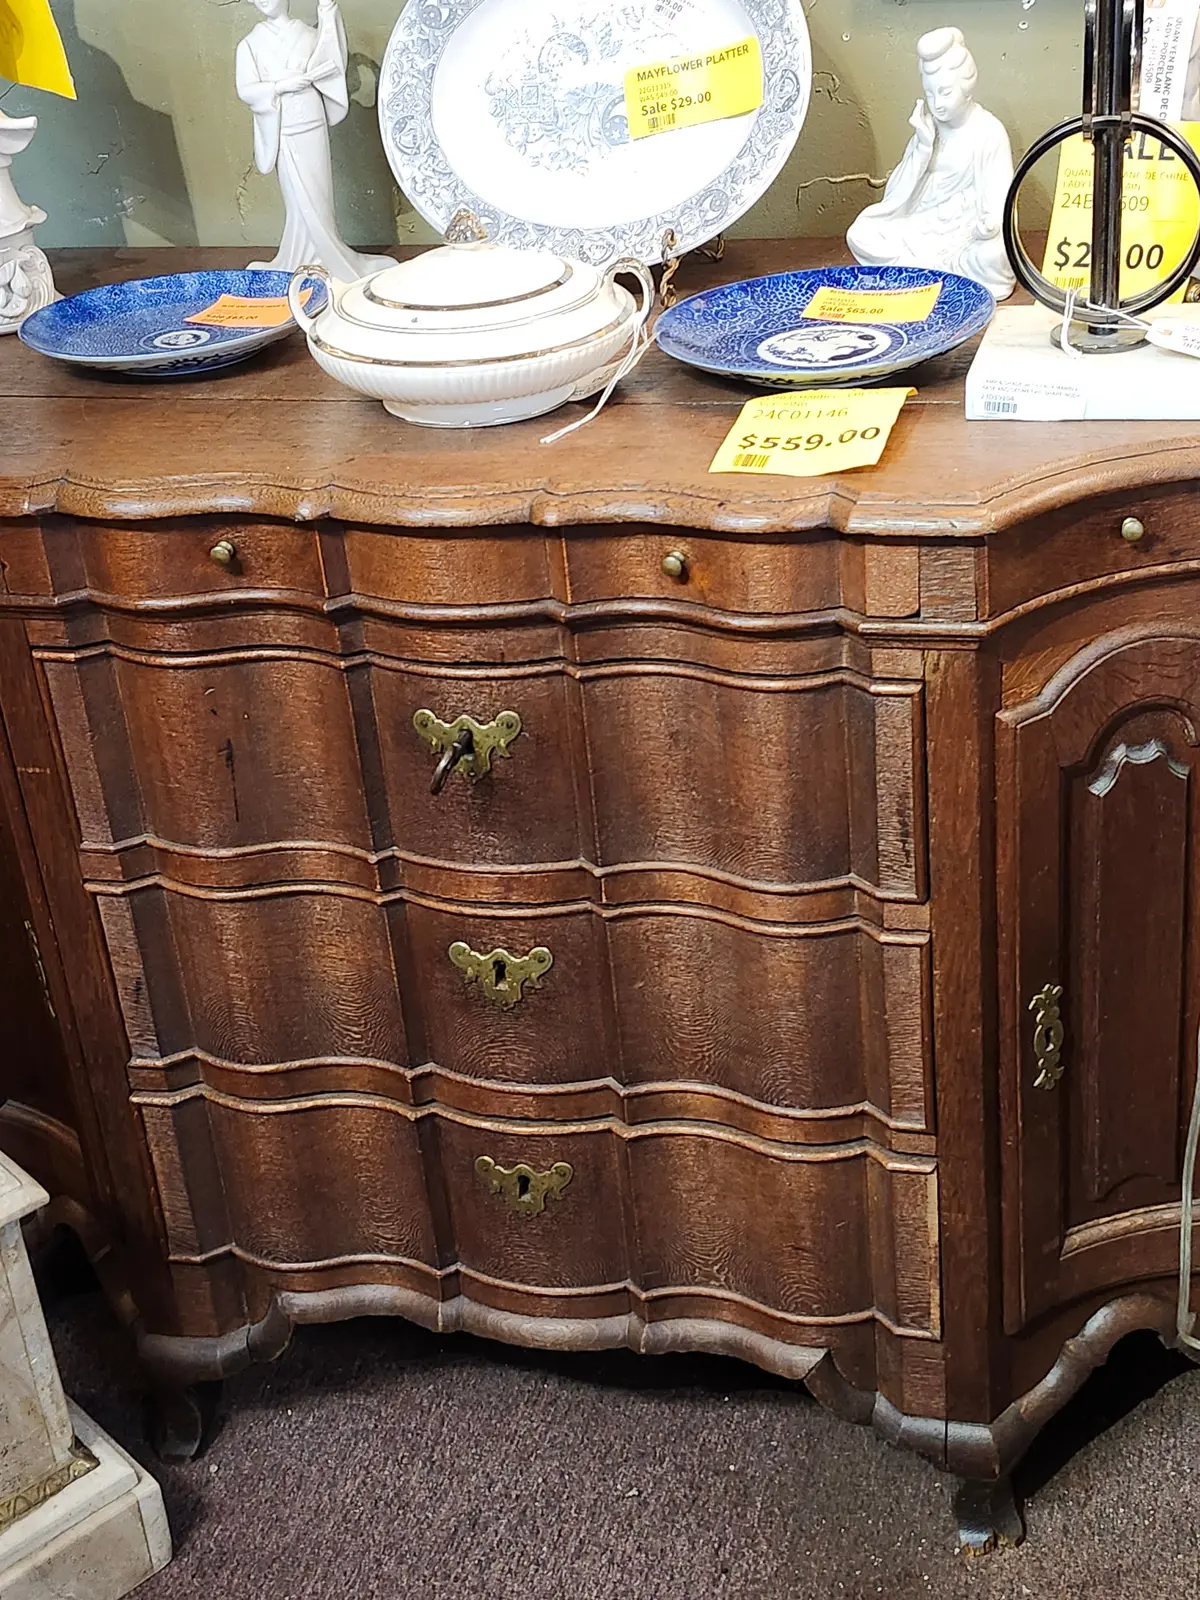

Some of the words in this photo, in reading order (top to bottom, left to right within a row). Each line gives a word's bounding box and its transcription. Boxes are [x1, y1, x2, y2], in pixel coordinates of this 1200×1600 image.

[1173, 17, 1183, 42] QUAN
[637, 58, 703, 82] MAYFLOWER
[705, 44, 749, 66] PLATTER
[1153, 42, 1168, 94] PORCELAIN
[1163, 65, 1175, 96] BLANC
[641, 101, 667, 116] Sale
[670, 91, 712, 110] $29.00
[1160, 98, 1169, 110] DE
[1145, 172, 1156, 180] DE
[819, 305, 844, 313] Sale
[845, 307, 884, 315] $65.00
[753, 407, 850, 420] 24C01146
[737, 427, 881, 451] $559.00
